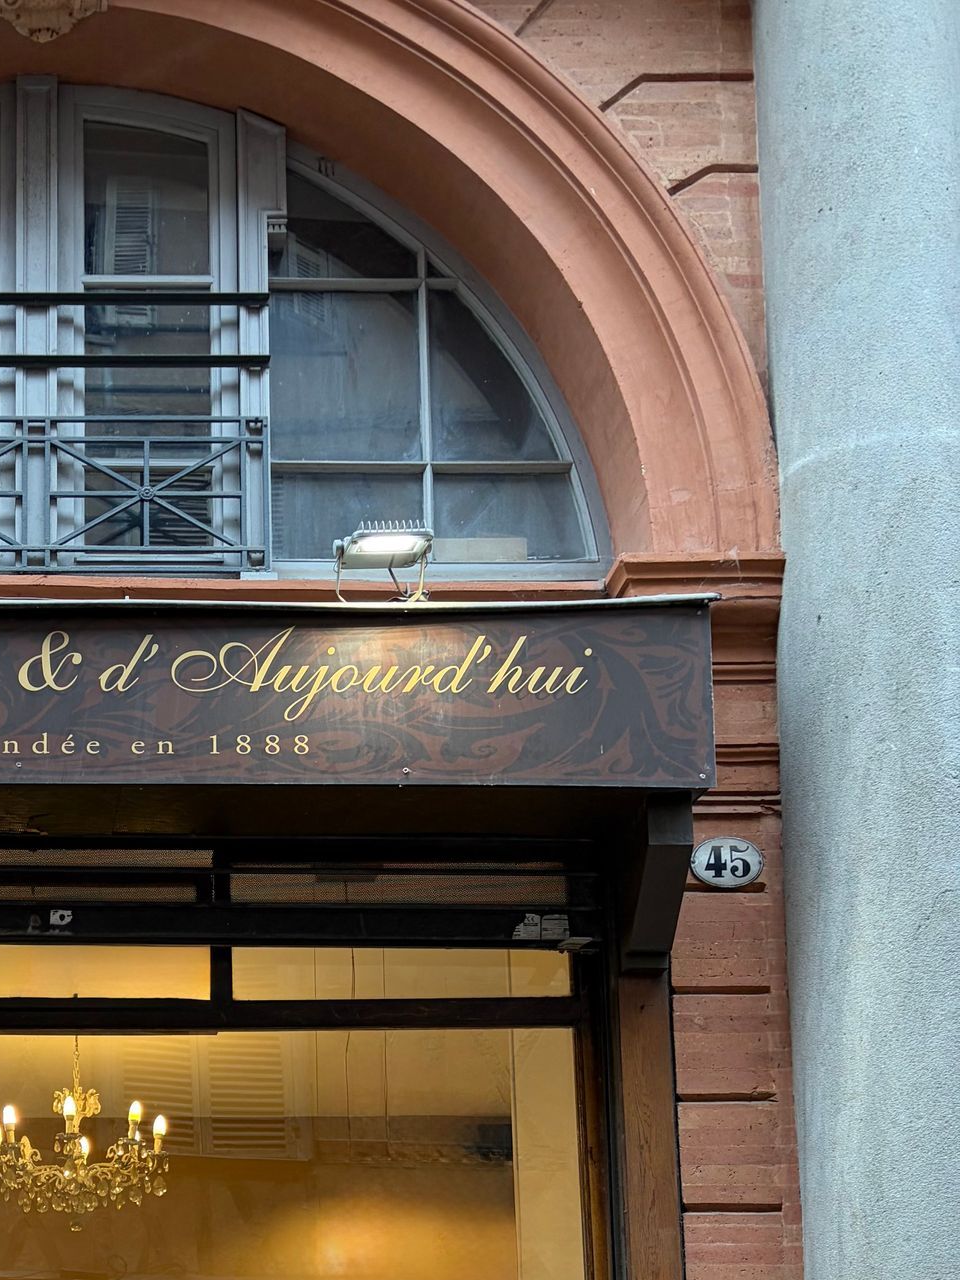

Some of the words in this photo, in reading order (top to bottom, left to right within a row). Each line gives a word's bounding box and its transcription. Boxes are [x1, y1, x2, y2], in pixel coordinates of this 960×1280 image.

[18, 630, 82, 692] &
[131, 740, 175, 755] en
[209, 734, 311, 756] 1888
[703, 843, 752, 879] 45
